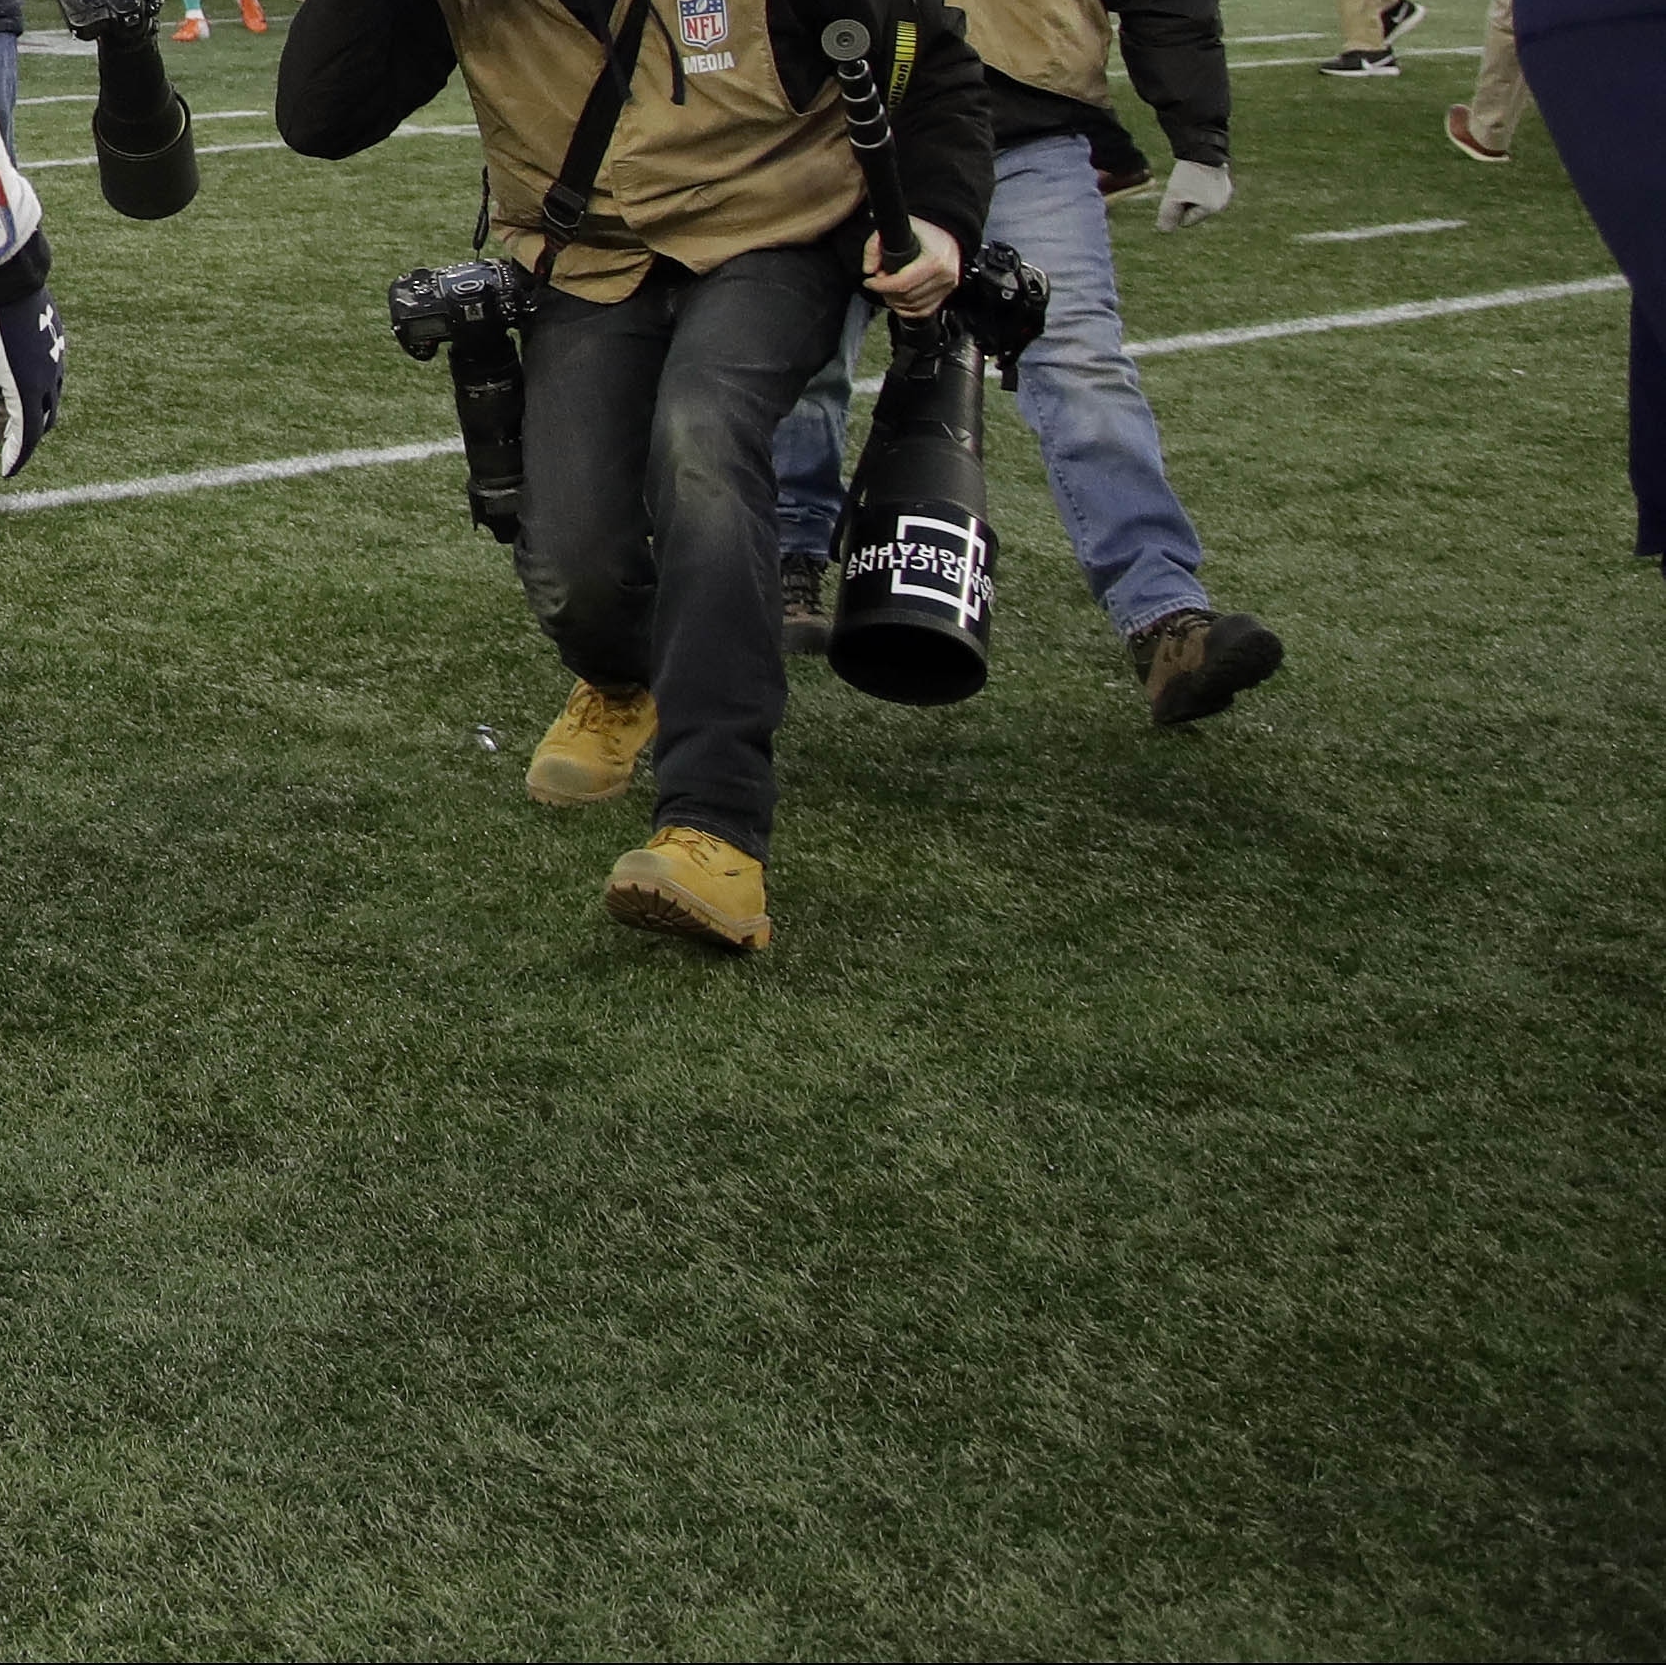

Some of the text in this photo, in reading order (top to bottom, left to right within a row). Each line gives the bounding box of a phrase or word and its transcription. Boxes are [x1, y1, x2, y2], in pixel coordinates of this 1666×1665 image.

[684, 14, 722, 41] NFL
[683, 51, 735, 75] MEDIA
[889, 63, 910, 106] Nikon
[845, 554, 962, 585] RICHINS
